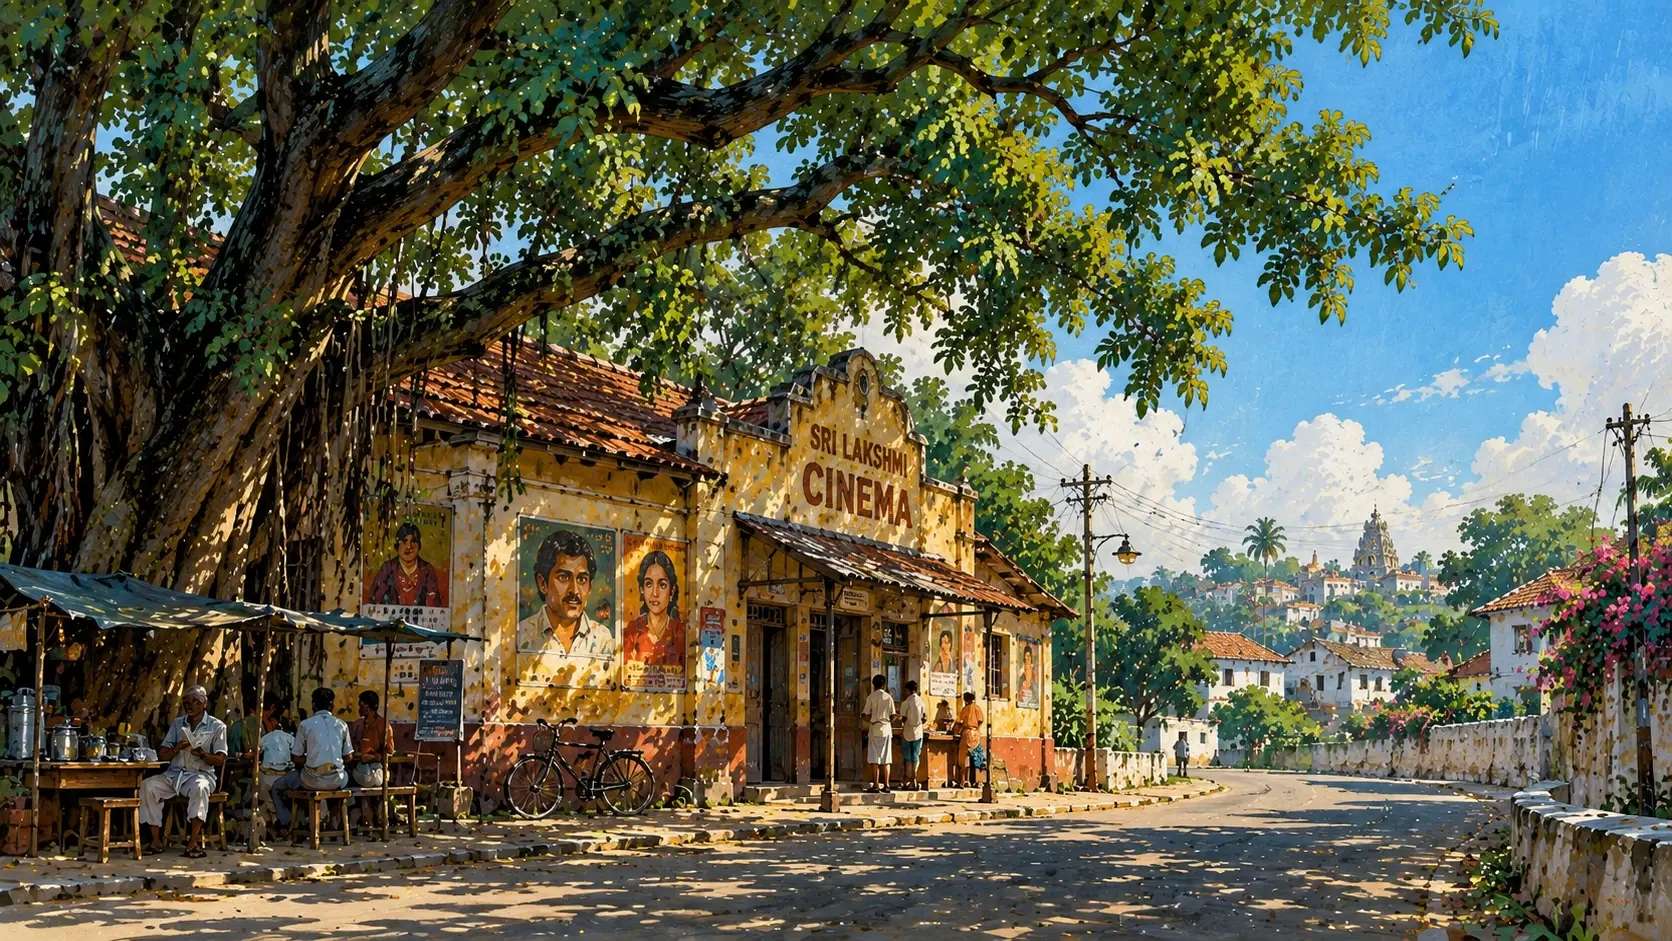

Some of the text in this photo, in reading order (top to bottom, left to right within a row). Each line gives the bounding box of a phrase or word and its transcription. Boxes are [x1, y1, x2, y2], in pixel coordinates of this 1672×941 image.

[810, 424, 908, 478] SRI LAKSHMI
[802, 462, 912, 529] CINEMA
